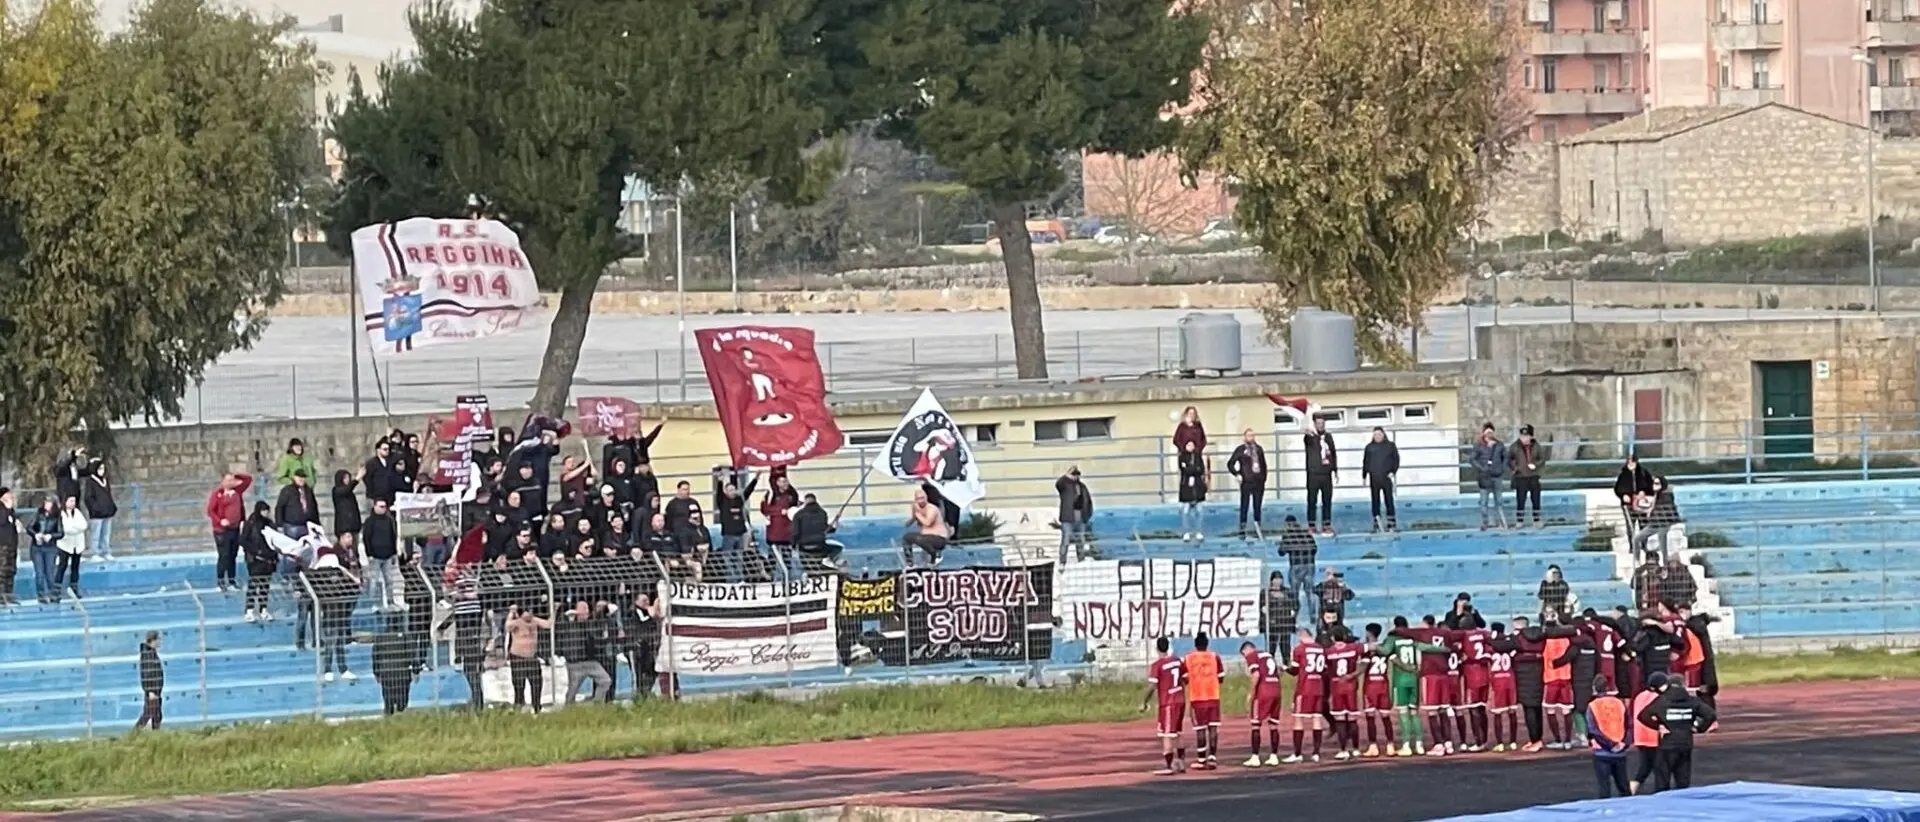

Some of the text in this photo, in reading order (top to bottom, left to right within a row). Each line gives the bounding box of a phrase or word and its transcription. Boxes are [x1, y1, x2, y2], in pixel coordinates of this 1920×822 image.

[406, 243, 525, 268] REGGINA
[436, 271, 511, 297] 1914
[669, 576, 830, 601] DIFFIDATI LIBERI
[897, 570, 1039, 608] CURVA
[1118, 559, 1215, 600] ALDO
[926, 606, 1008, 643] SUD
[1073, 600, 1254, 640] NON MOLLARE
[1603, 634, 1613, 652] 6
[682, 642, 812, 672] Reggio Calabria
[1266, 657, 1276, 676] 9
[1305, 654, 1325, 673] 30
[1336, 658, 1348, 676] 8
[1491, 653, 1511, 671] 20
